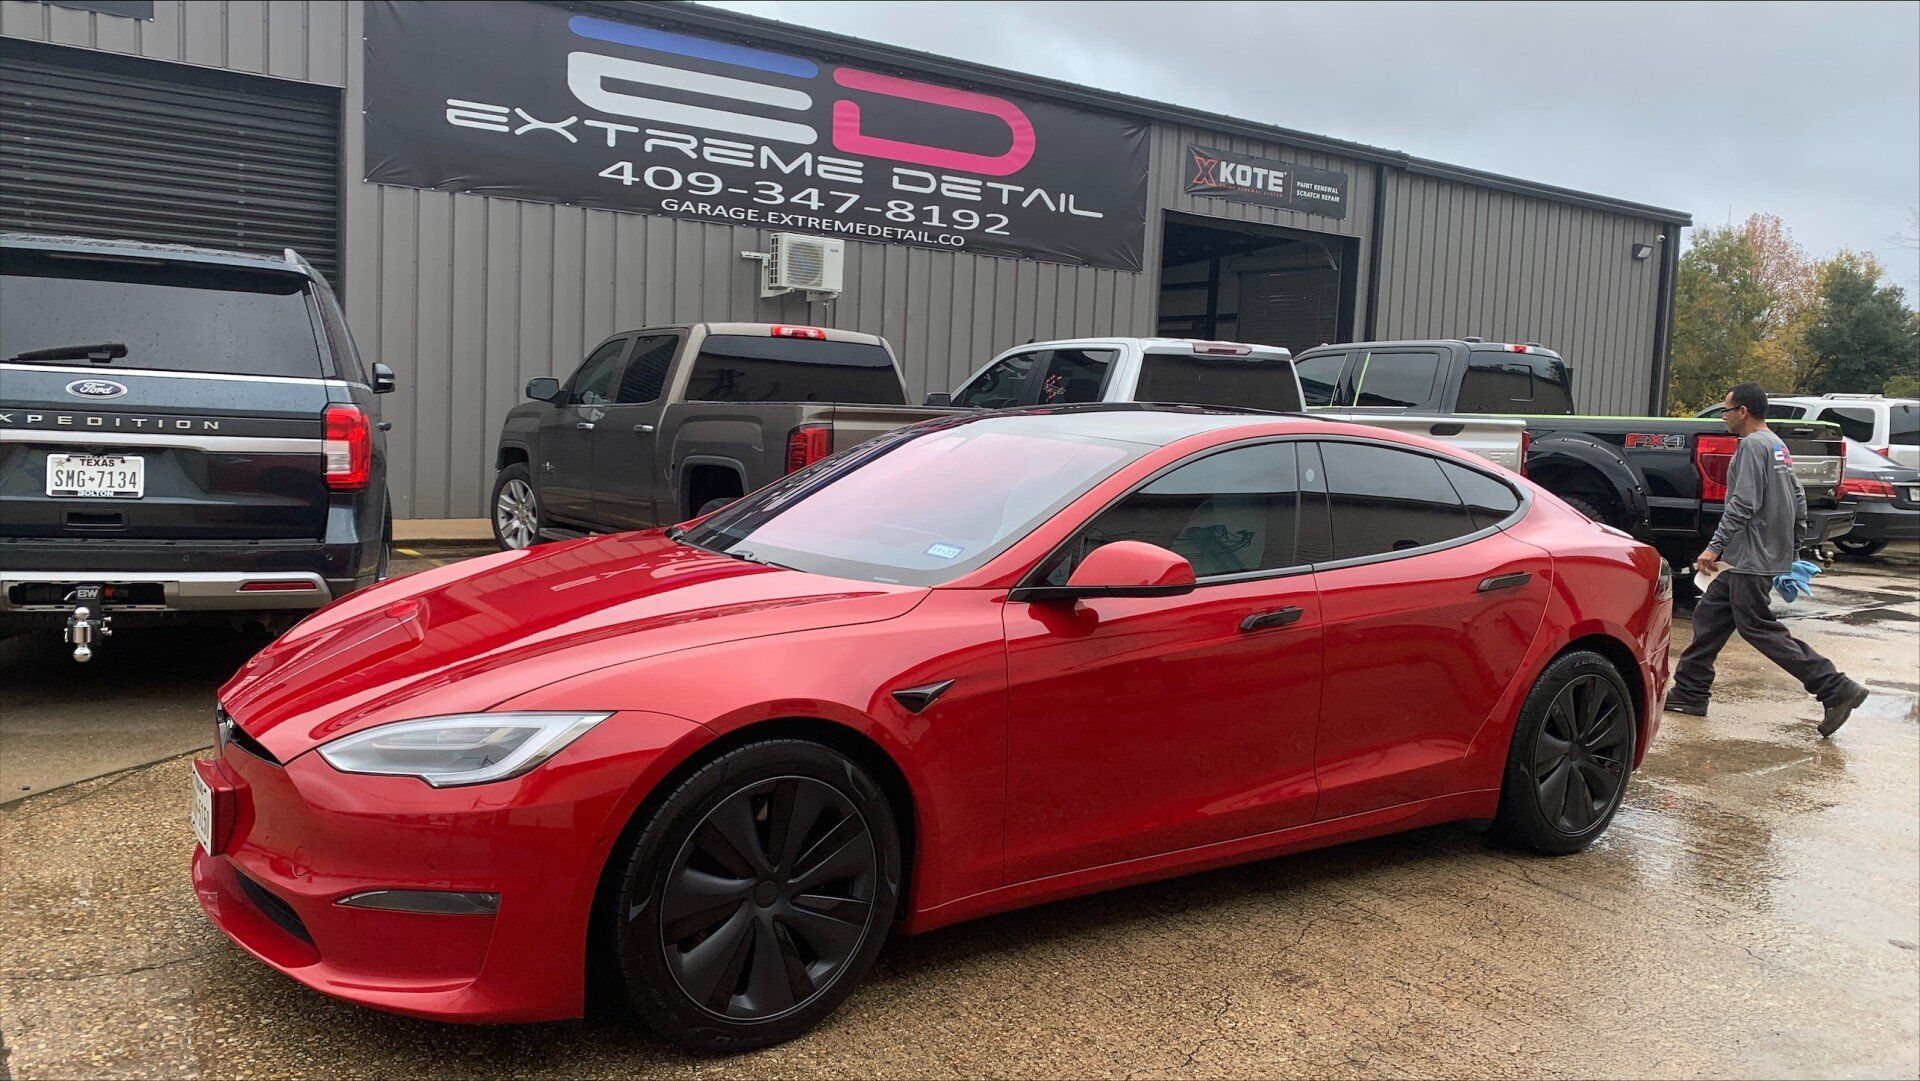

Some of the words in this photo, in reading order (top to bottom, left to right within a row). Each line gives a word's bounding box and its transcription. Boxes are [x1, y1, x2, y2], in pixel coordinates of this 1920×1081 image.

[446, 98, 865, 182] EXTREME
[892, 166, 1104, 219] DETAIL
[1296, 181, 1313, 190] PAINT
[1313, 184, 1339, 194] RENEWAL
[598, 160, 1012, 236] 409-347-8192
[1296, 189, 1320, 200] SCRATCH
[1321, 194, 1340, 202] REPAIR
[660, 198, 966, 246] GARAGE.EXTREMEDETAIL.CO
[79, 382, 113, 395] Ford
[1625, 433, 1686, 449] FX4
[80, 458, 115, 467] TEXAS
